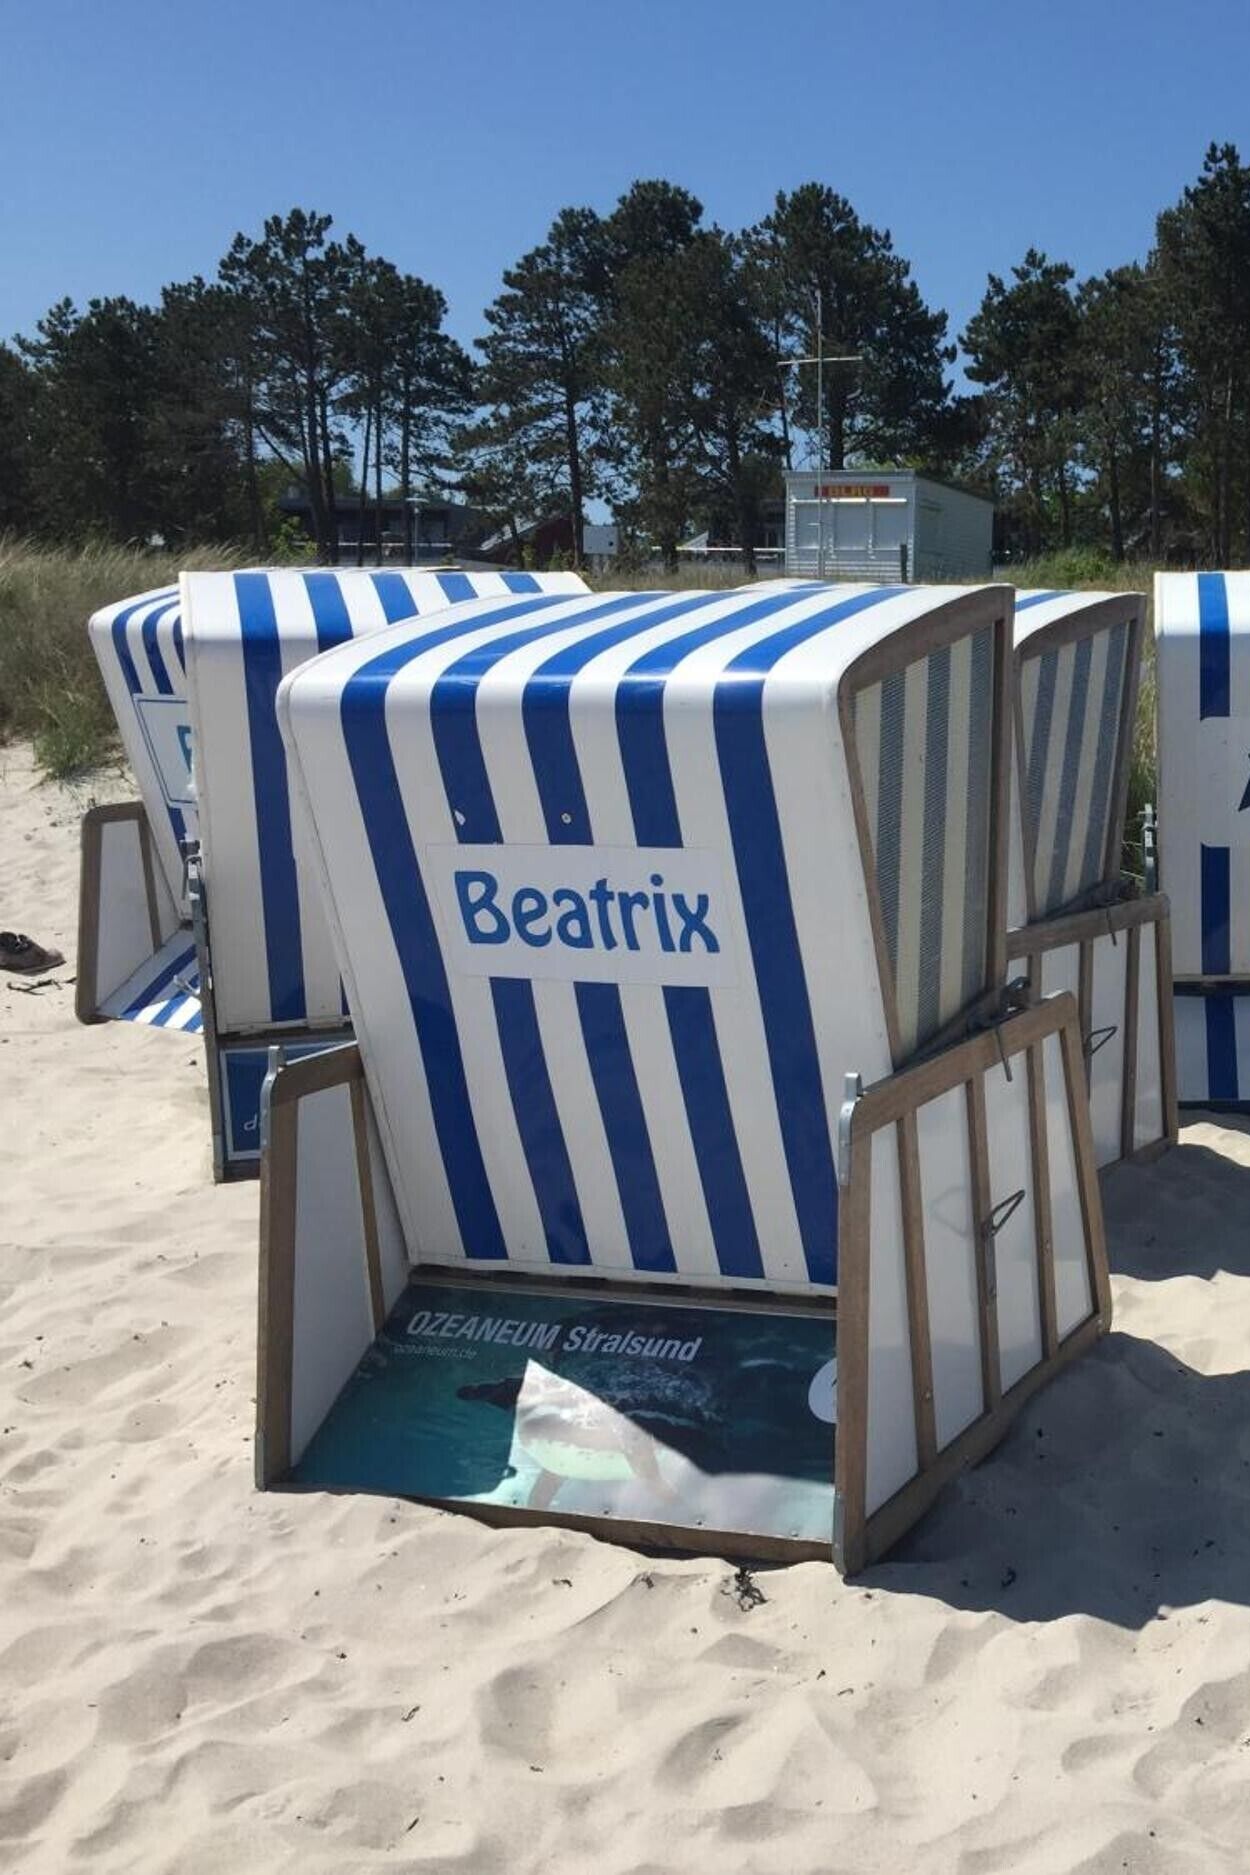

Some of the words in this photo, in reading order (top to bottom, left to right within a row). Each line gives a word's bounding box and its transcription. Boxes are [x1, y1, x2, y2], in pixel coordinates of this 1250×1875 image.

[454, 871, 720, 953] Beatrix
[407, 1311, 560, 1350] OZEANEUM
[563, 1326, 702, 1362] Stralsund
